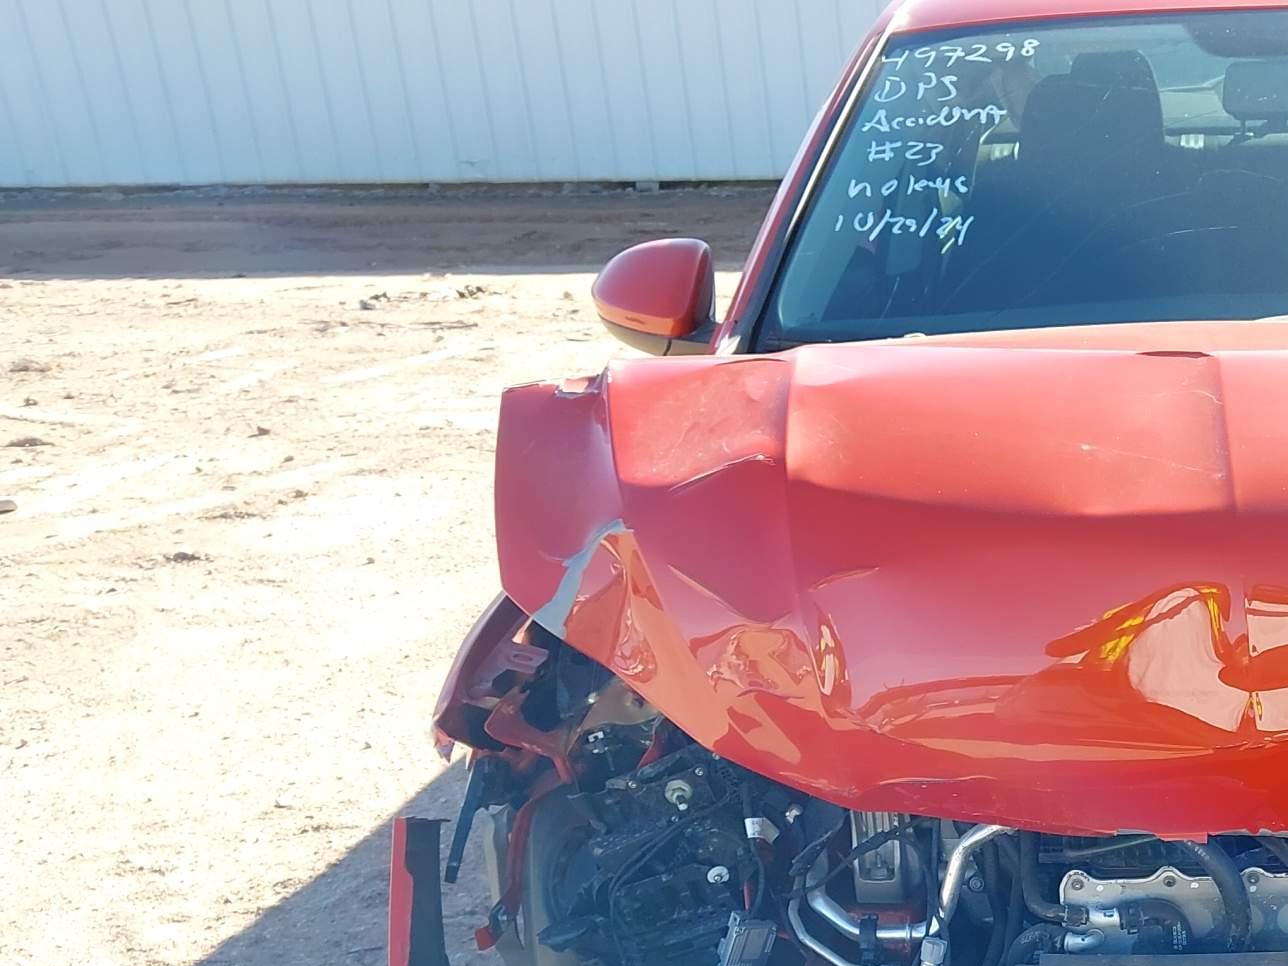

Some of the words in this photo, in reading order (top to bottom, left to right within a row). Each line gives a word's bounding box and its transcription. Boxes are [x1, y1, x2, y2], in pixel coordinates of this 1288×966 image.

[881, 39, 1040, 71] 497298
[874, 72, 958, 102] DPS
[866, 140, 944, 166] #23
